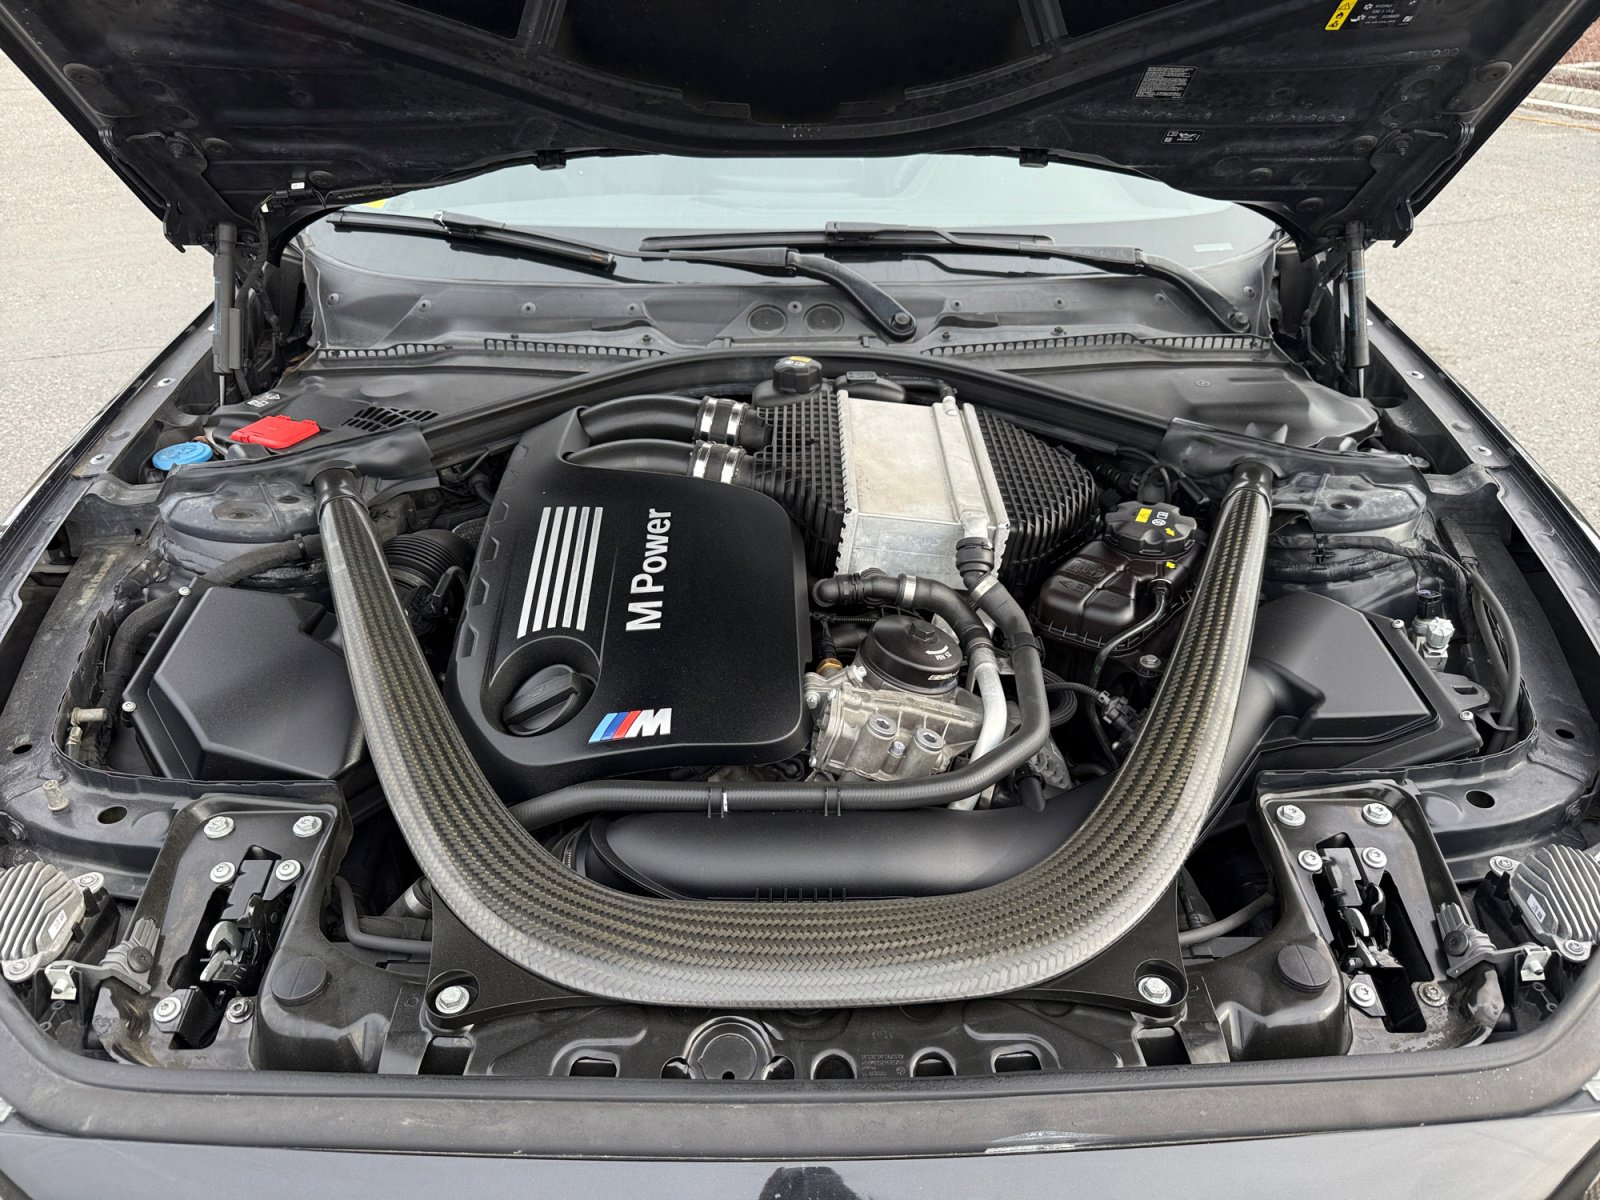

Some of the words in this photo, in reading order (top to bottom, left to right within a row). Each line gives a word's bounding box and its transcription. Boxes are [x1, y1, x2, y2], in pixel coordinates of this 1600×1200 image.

[630, 508, 672, 595] Power
[626, 600, 663, 632] M
[624, 708, 672, 738] M
